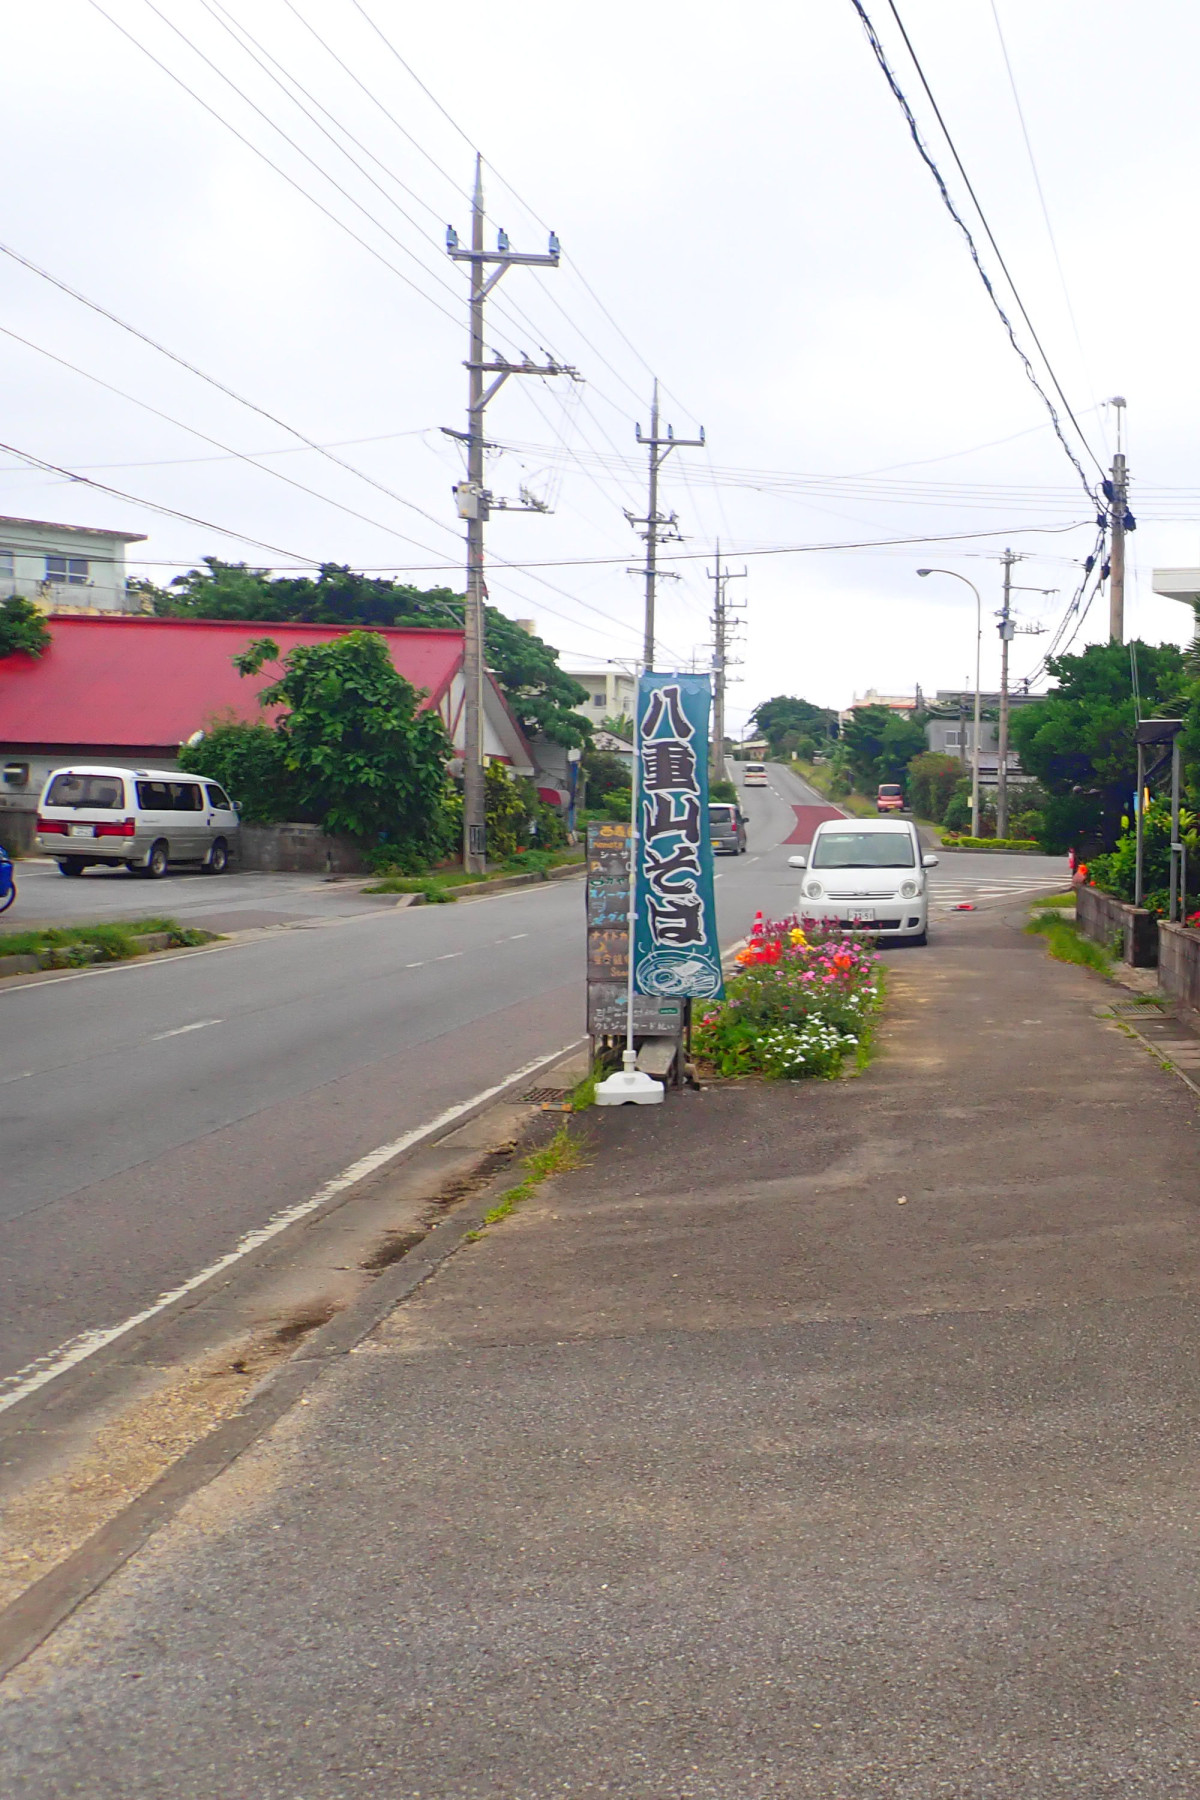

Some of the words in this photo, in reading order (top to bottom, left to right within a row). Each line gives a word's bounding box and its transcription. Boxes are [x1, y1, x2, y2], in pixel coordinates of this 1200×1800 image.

[640, 685, 706, 947] 八重山そば
